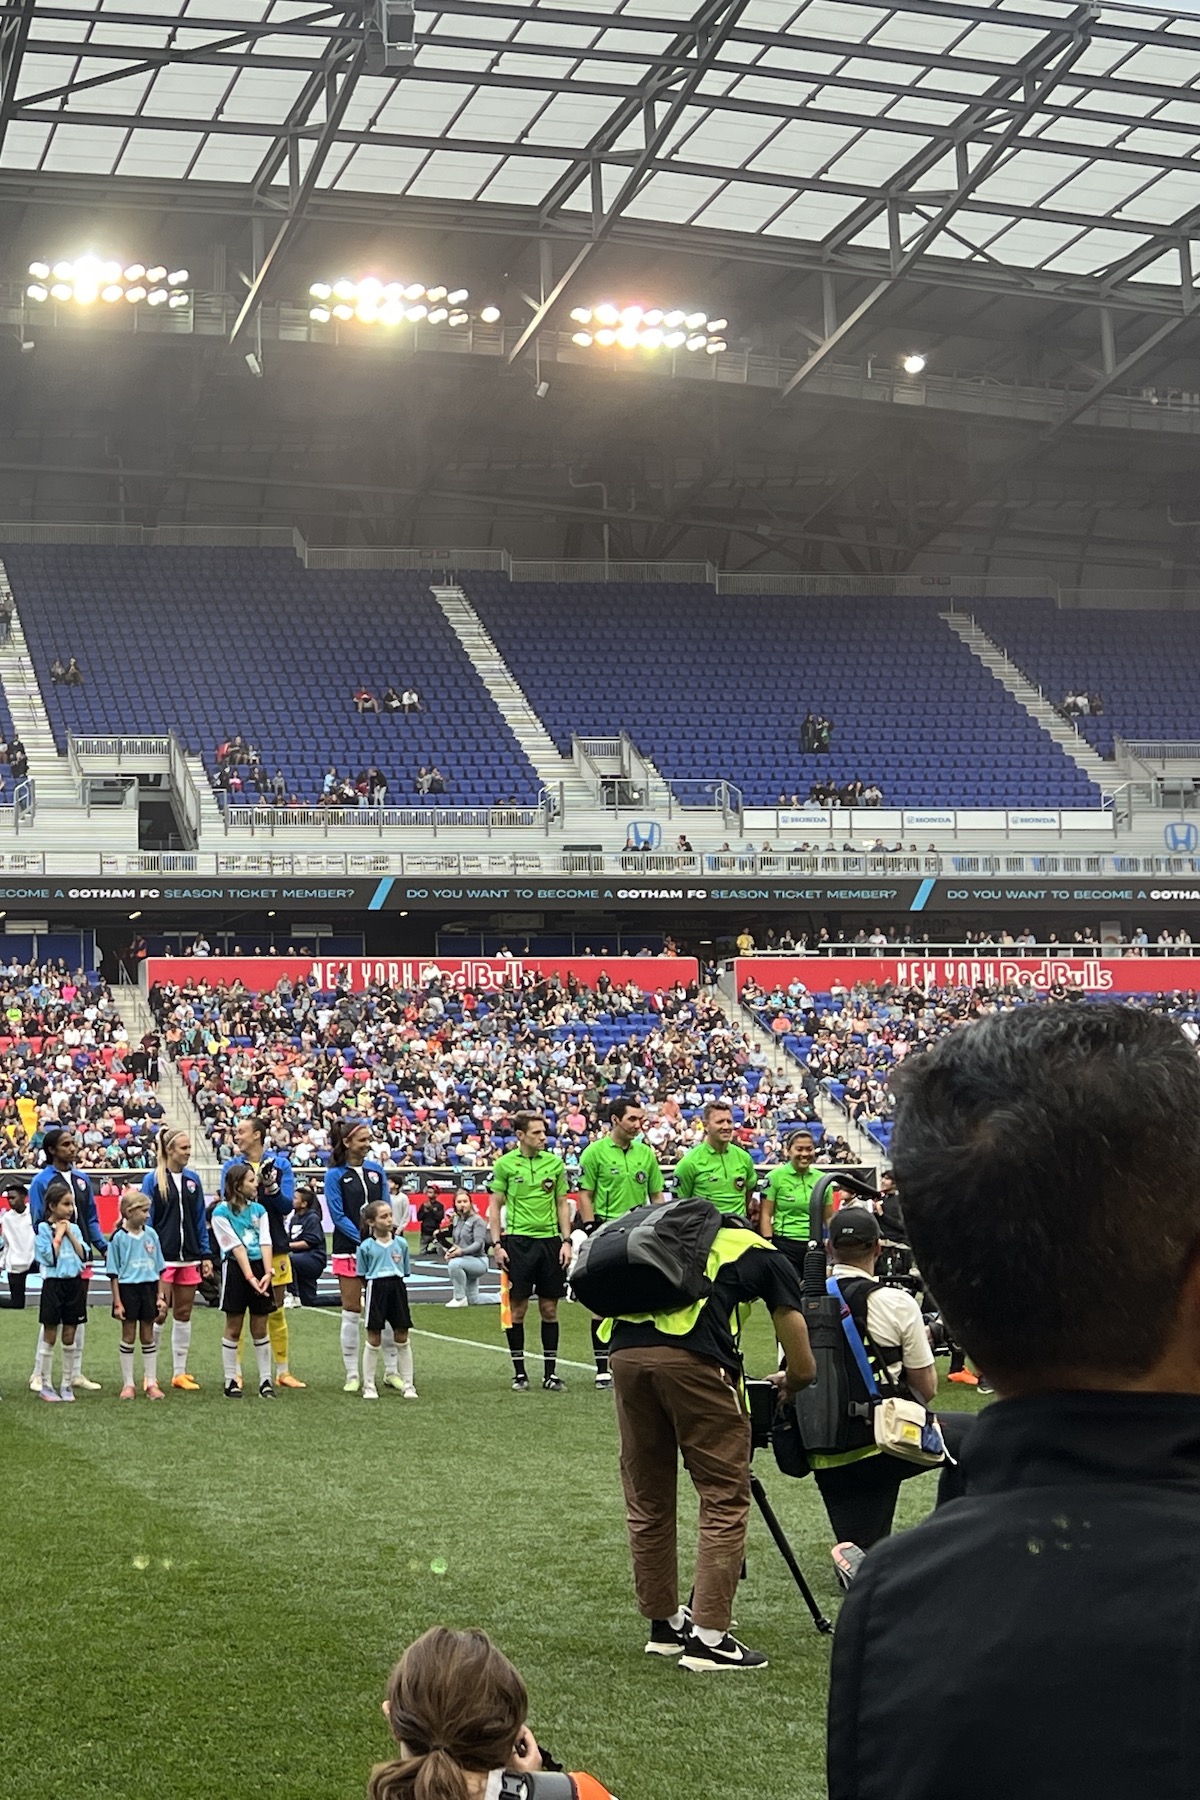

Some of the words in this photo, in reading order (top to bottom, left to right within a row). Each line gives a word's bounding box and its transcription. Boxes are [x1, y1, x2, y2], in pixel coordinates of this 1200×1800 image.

[53, 889, 65, 898] A
[67, 888, 136, 899] GOTHAM
[139, 888, 161, 899] FC
[163, 889, 224, 899] SEASON
[227, 889, 278, 898] TICKET
[282, 888, 355, 899] MEMBER?
[406, 889, 429, 899] DO
[432, 889, 463, 899] YOU
[466, 889, 510, 899] WANT
[514, 889, 534, 899] TO
[537, 889, 599, 899] BECOME
[603, 889, 614, 899] A
[616, 889, 684, 899] GOTHAM
[686, 889, 707, 899] FC
[710, 889, 769, 899] SEASON
[773, 889, 823, 899] TICKET
[826, 889, 898, 899] MEMBER?
[947, 889, 969, 900] DO
[972, 889, 1002, 900] YOU
[1005, 890, 1048, 900] WANT
[1050, 890, 1070, 900] TO
[1073, 890, 1133, 900] BECOME
[1136, 890, 1147, 900] A
[361, 962, 413, 990] YORK
